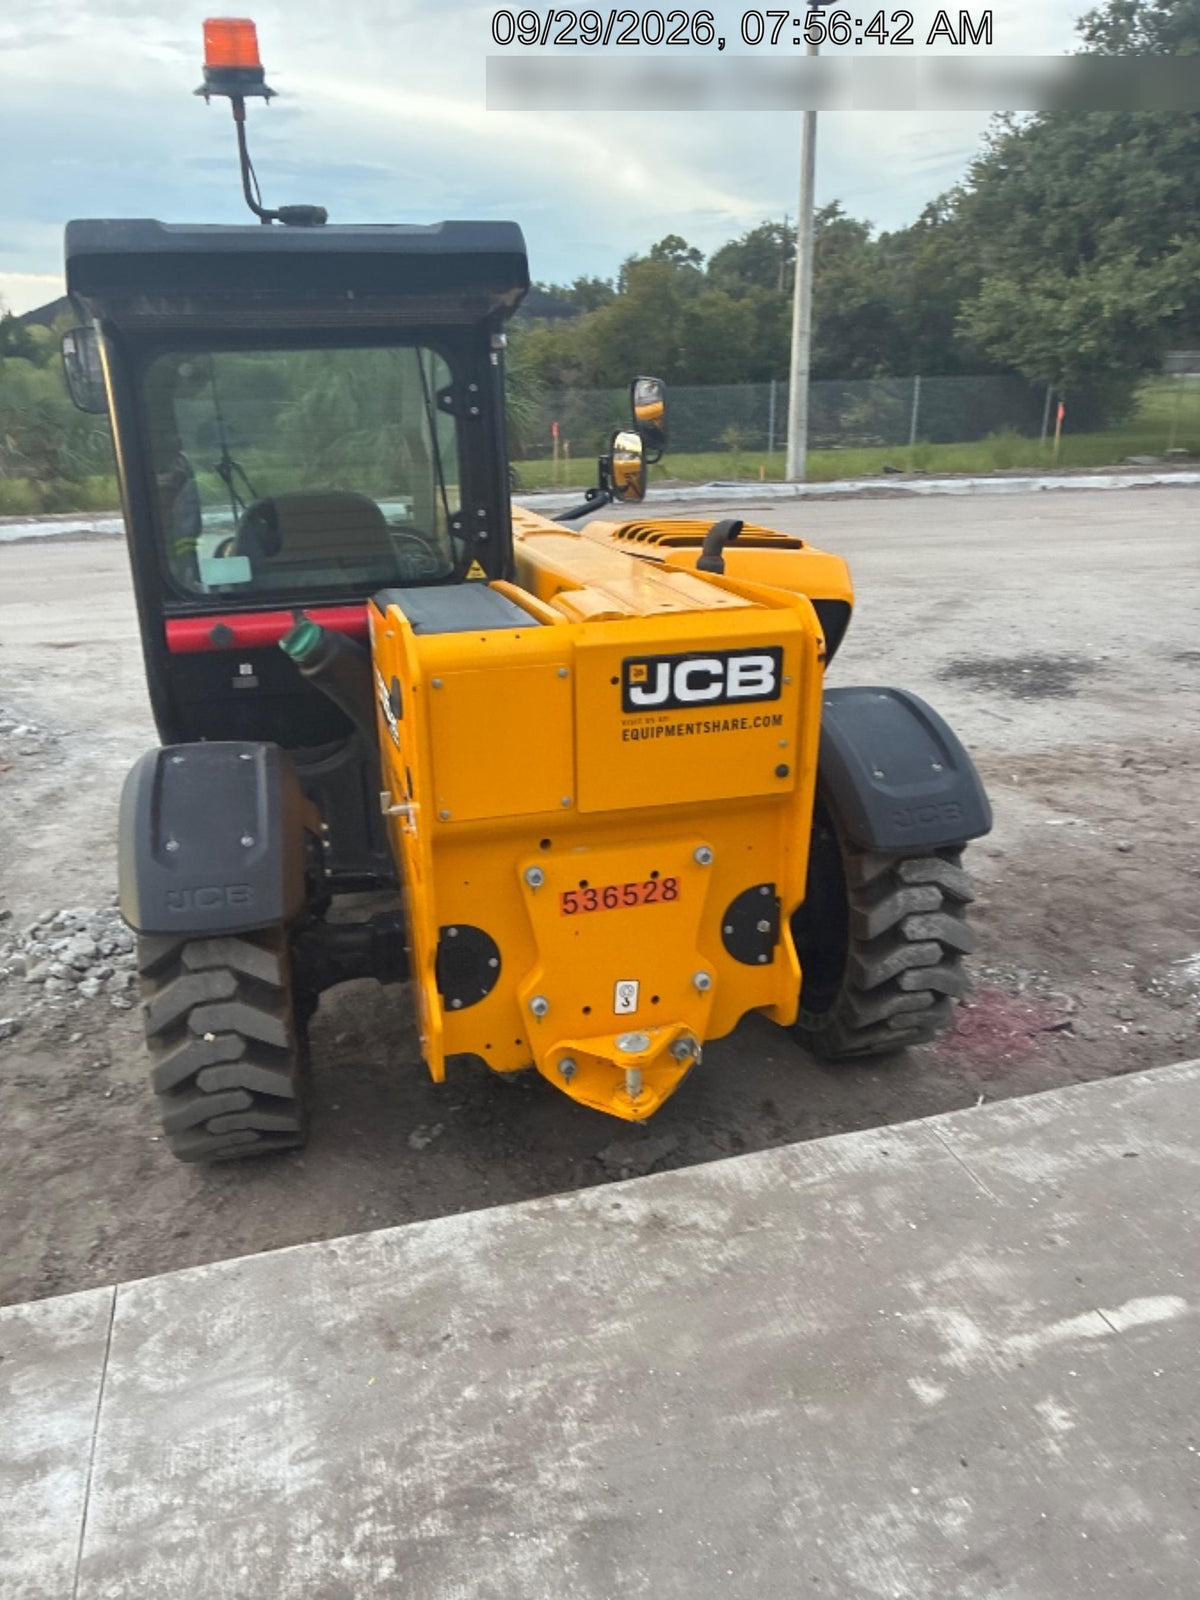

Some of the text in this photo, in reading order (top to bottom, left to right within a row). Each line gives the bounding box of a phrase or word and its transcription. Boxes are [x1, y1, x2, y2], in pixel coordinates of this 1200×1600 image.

[630, 655, 776, 705] JCB
[621, 714, 783, 742] EQUIPMENTSHARE.COM
[891, 801, 964, 830] JCB
[165, 883, 254, 912] JCB
[562, 877, 678, 915] 536528
